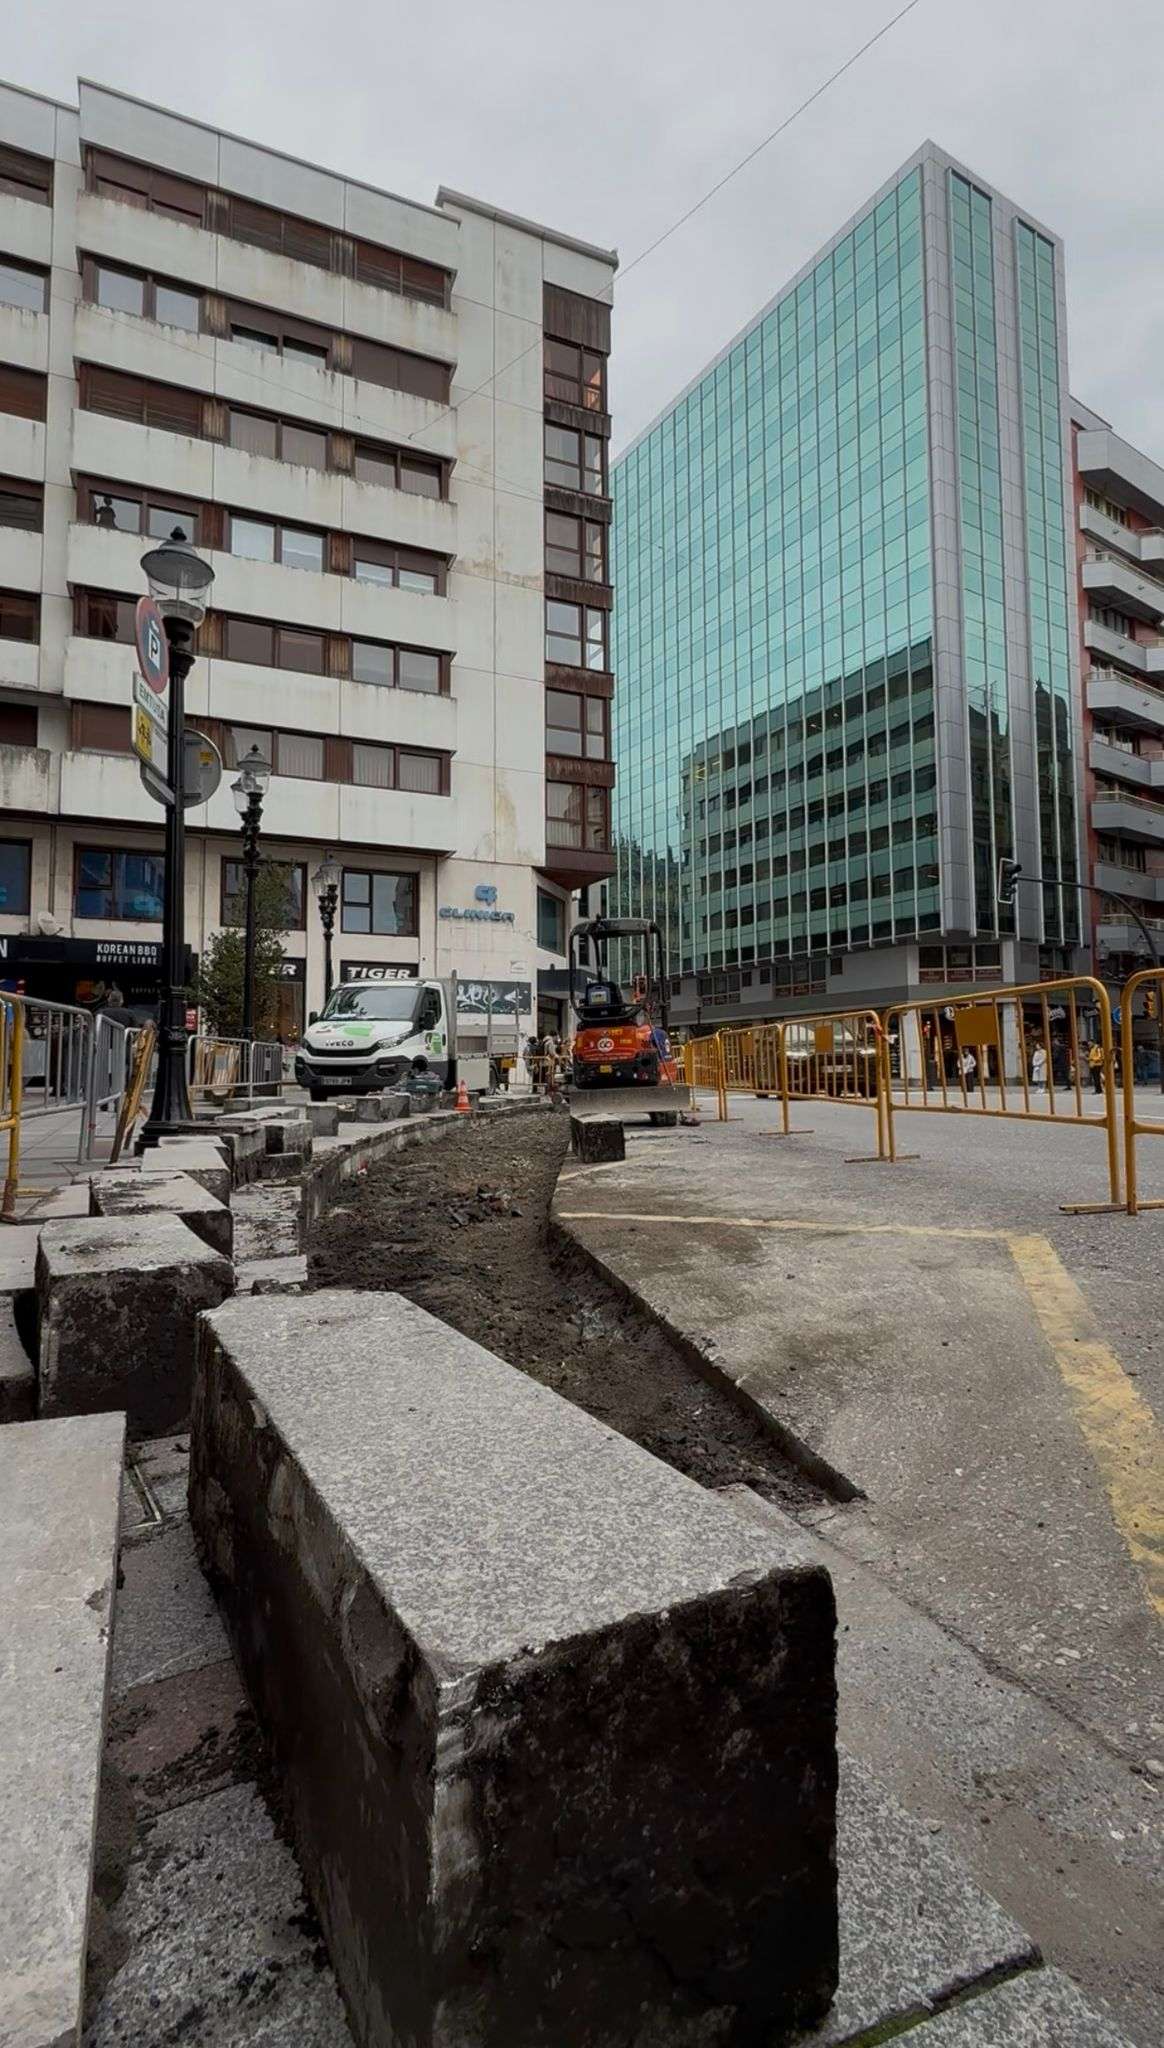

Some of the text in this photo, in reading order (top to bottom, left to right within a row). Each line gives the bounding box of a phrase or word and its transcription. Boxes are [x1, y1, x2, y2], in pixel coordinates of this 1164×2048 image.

[96, 943, 157, 956] KOREAN BBQ
[96, 955, 157, 965] BUFFET LIBRE
[347, 967, 411, 979] TIGER
